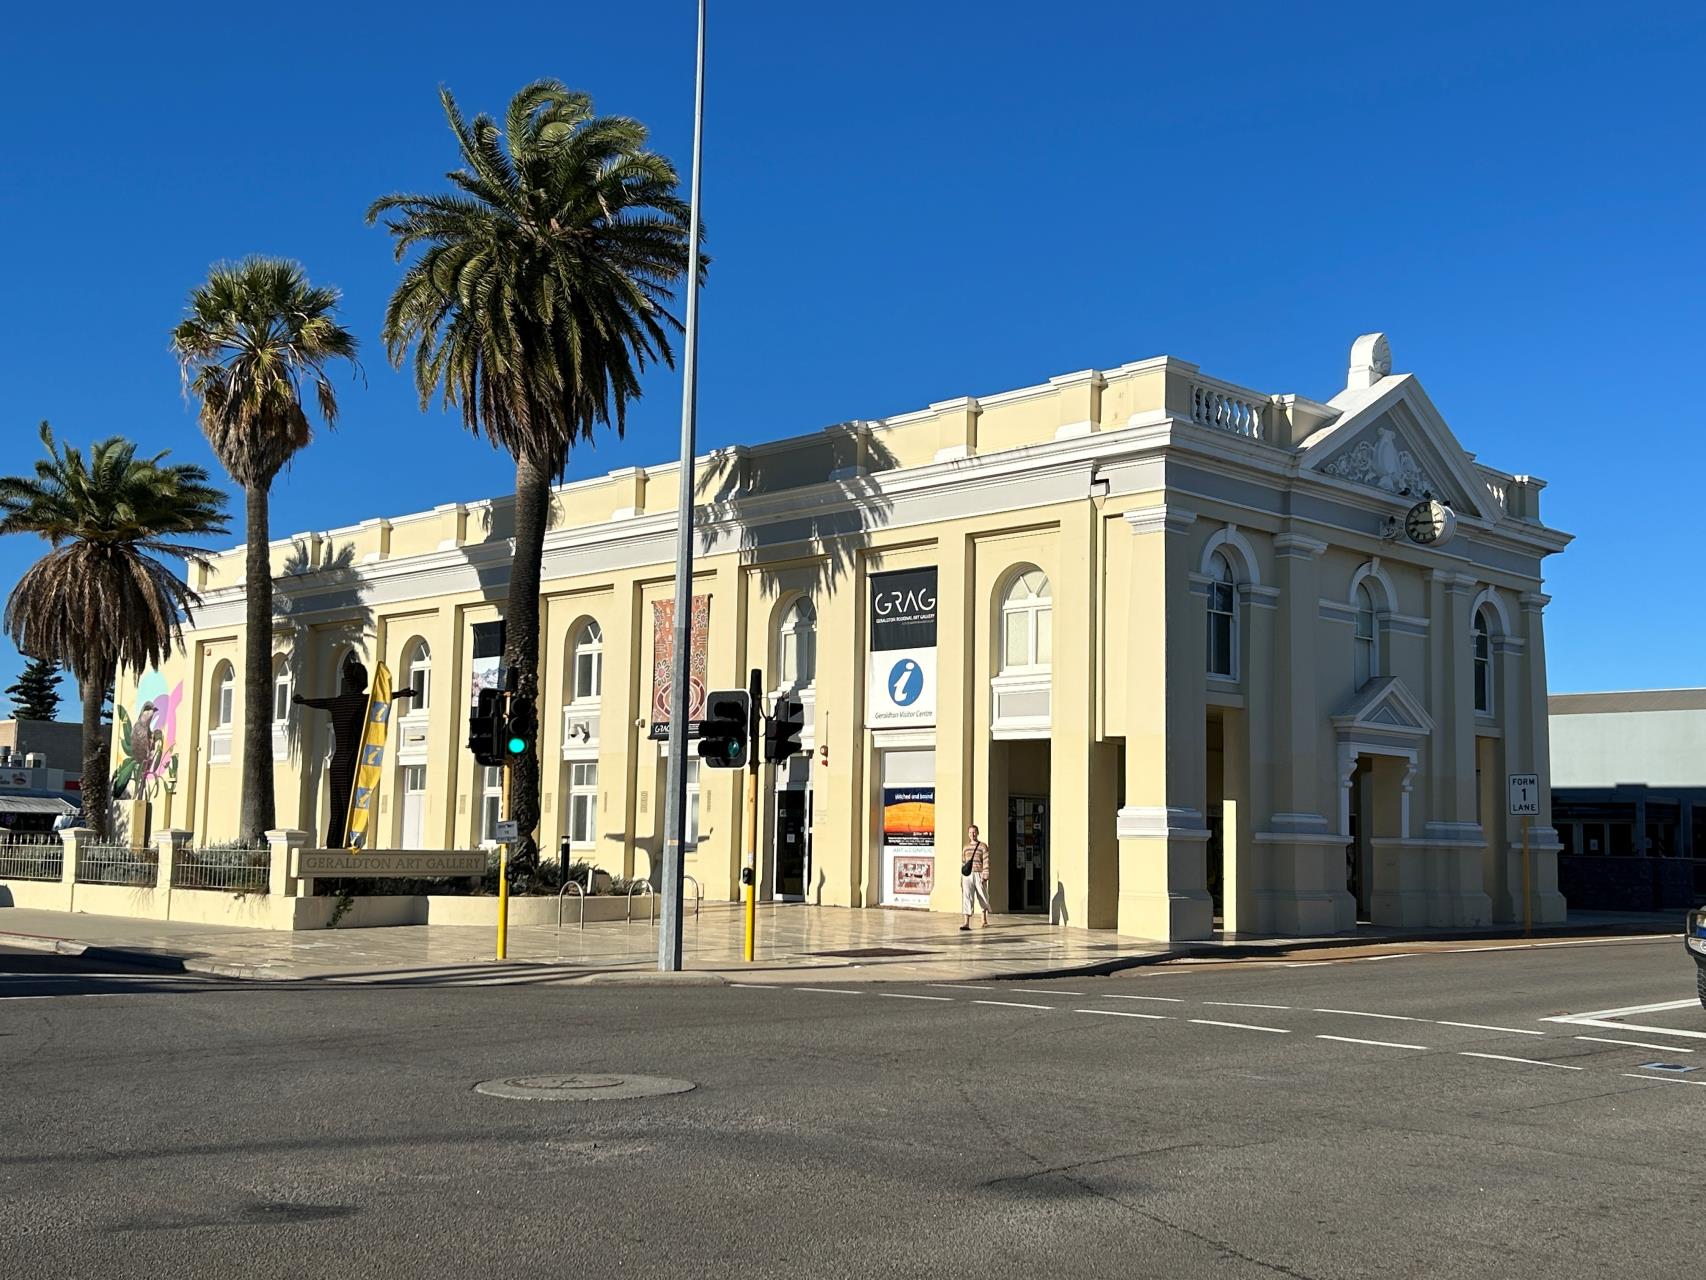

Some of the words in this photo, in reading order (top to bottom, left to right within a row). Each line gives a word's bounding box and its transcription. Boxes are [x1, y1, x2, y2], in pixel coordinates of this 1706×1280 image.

[874, 587, 936, 615] GRAG
[875, 711, 899, 719] Geraldton
[900, 710, 915, 718] Visitor
[916, 710, 933, 718] Centre
[1512, 778, 1535, 786] FORM
[1521, 788, 1527, 802] 1
[1512, 803, 1537, 812] LANE
[306, 857, 391, 869] GERALDTON
[395, 857, 422, 869] ART
[426, 857, 481, 869] GALLERY
